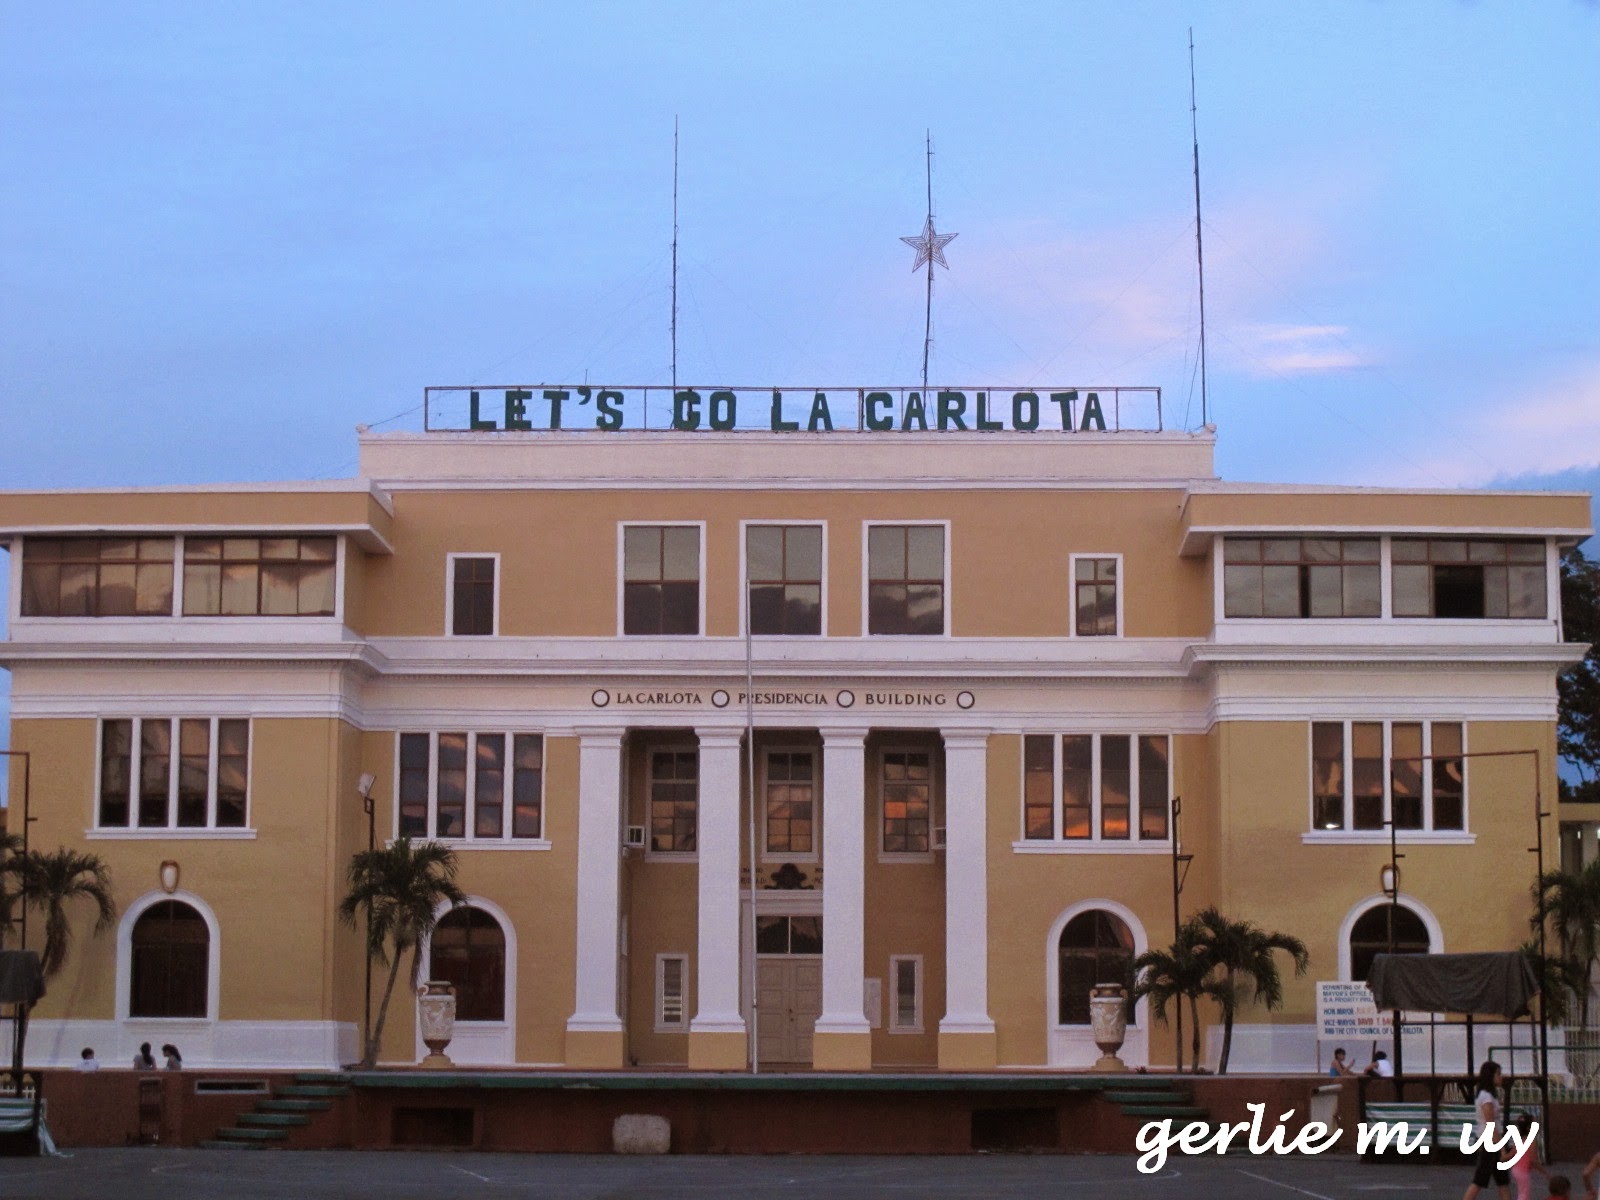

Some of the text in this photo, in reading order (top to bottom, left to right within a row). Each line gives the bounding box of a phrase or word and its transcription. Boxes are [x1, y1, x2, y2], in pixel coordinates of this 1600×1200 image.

[470, 388, 1107, 432] LET'S GO LA CARLOTA
[865, 693, 946, 706] BUILDING
